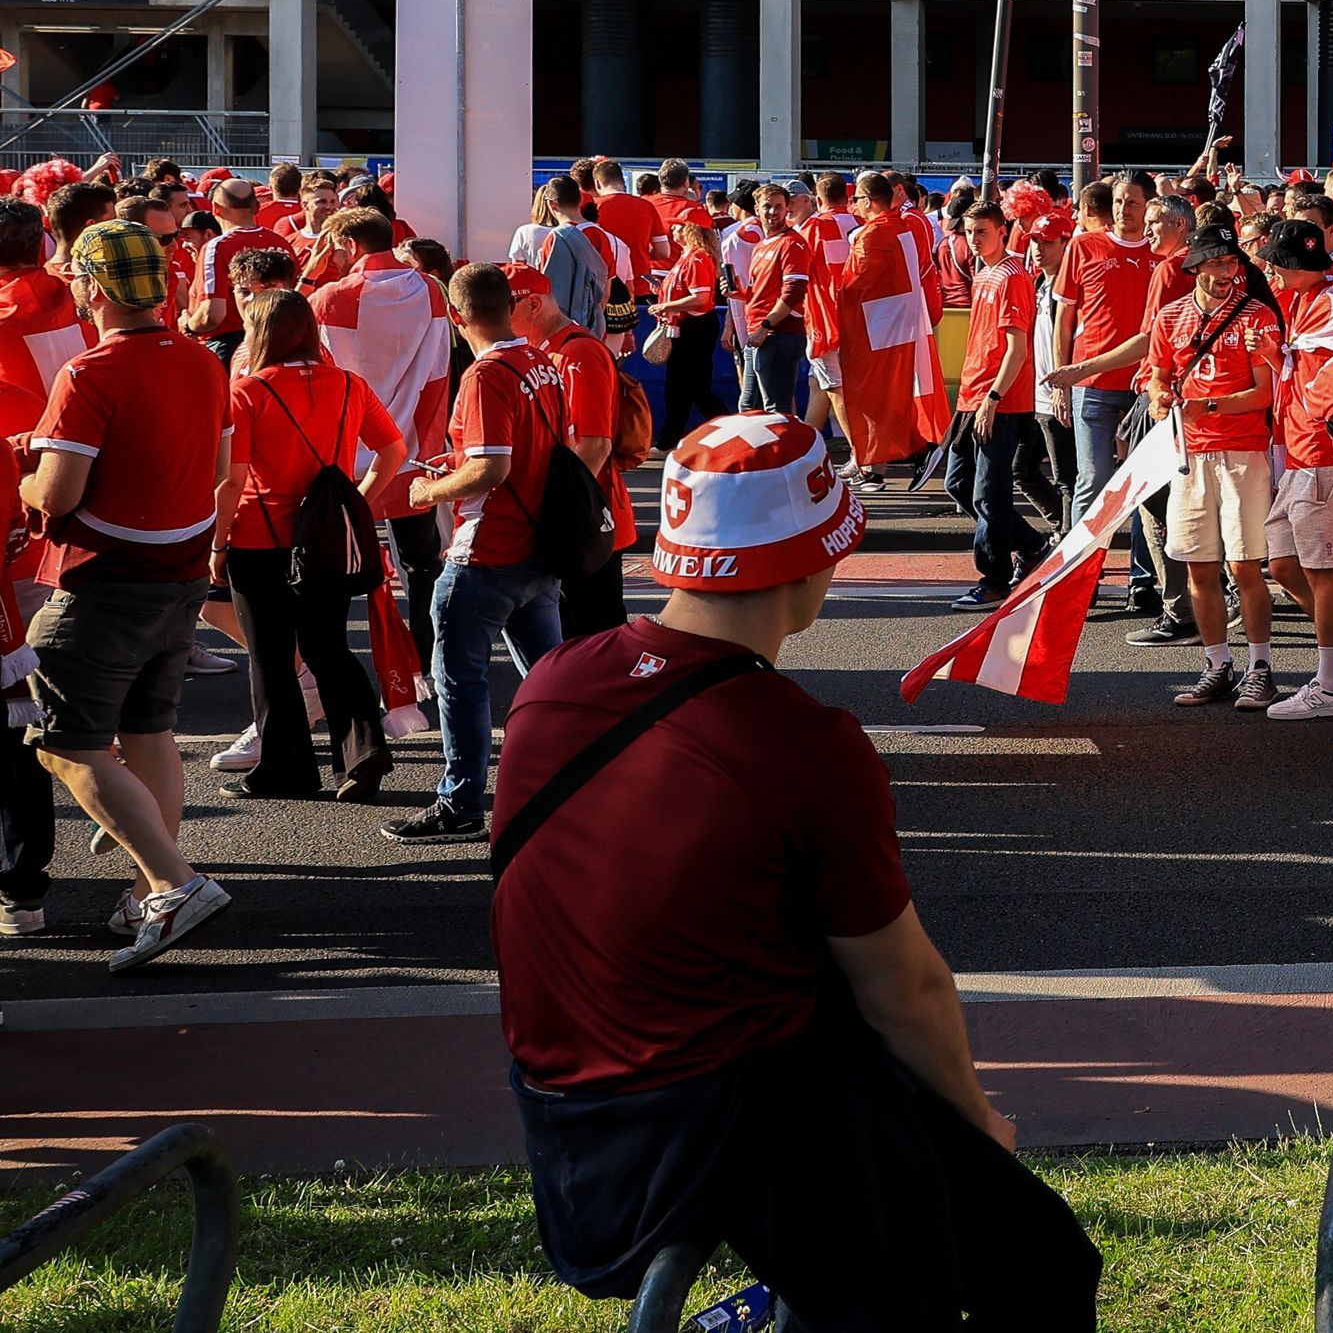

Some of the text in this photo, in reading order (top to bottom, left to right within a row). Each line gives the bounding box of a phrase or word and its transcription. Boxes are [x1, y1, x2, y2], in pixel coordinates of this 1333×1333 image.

[830, 146, 864, 154] Food &
[821, 517, 859, 556] HOPP
